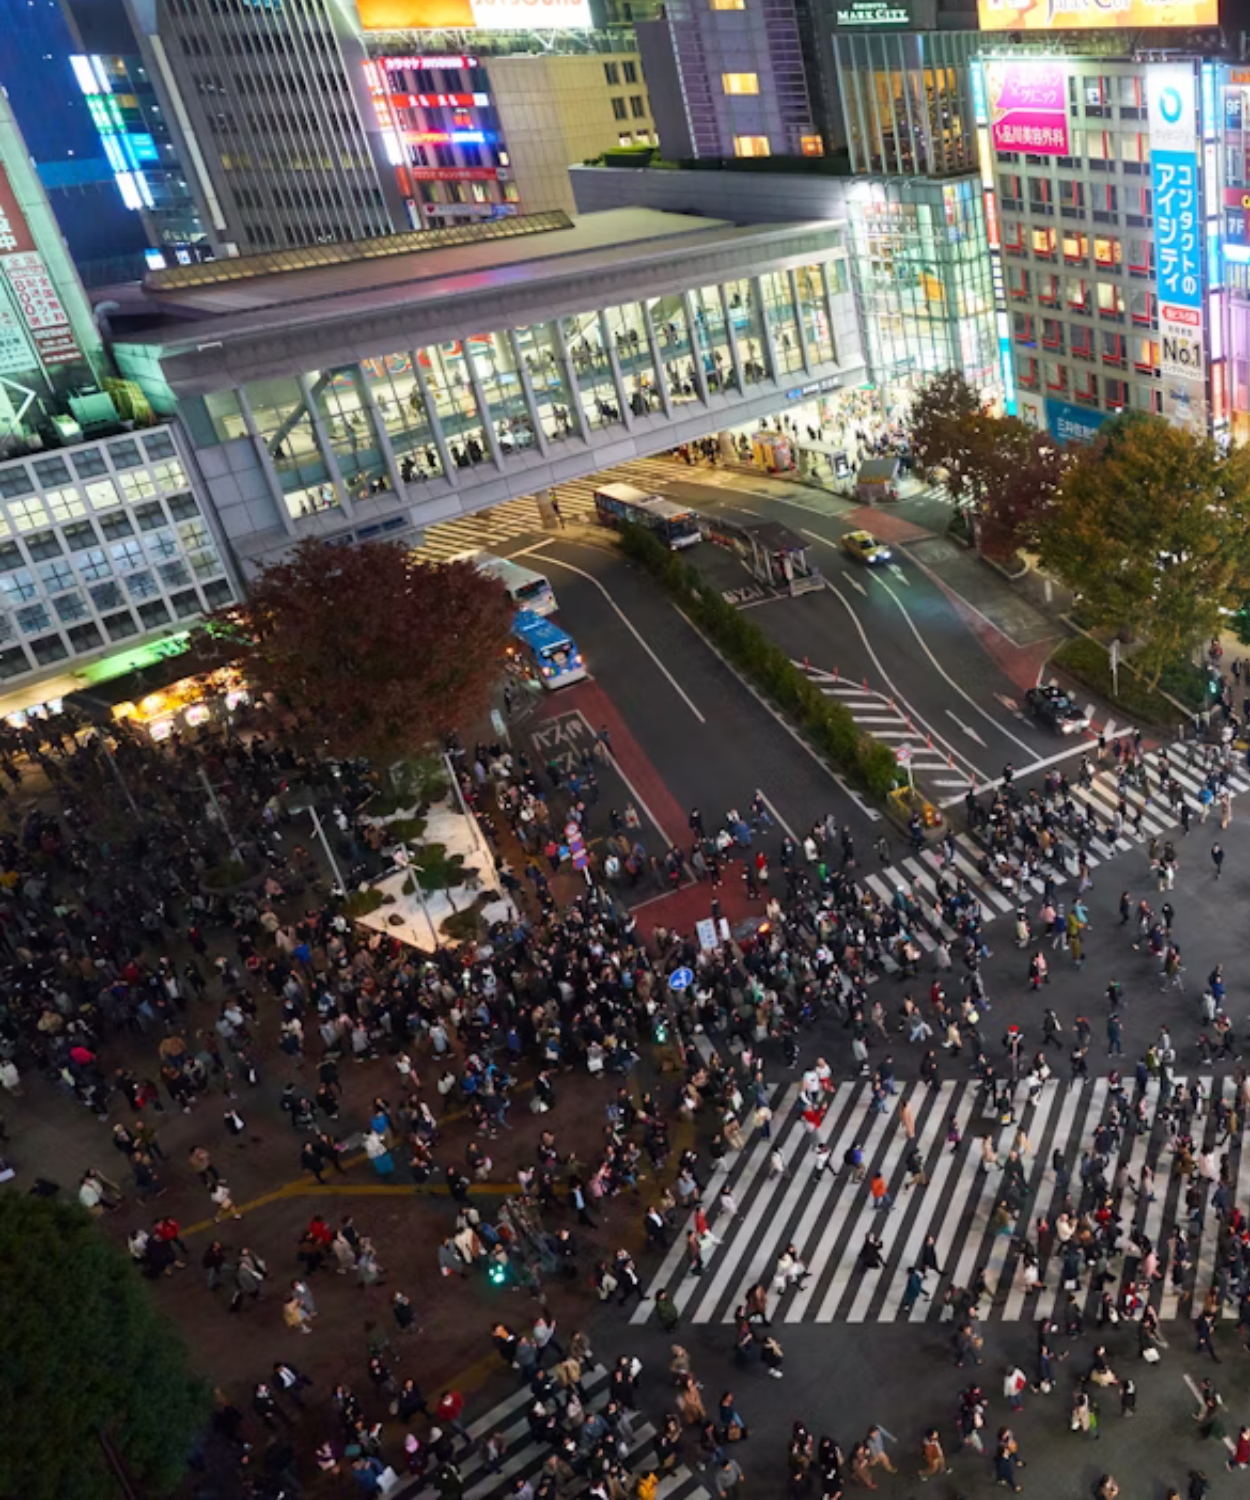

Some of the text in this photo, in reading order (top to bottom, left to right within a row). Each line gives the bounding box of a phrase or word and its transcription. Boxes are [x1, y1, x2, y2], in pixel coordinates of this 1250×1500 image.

[1155, 163, 1180, 293] アイシティ
[1178, 165, 1197, 296] コンタクトの
[1163, 337, 1201, 367] No.1
